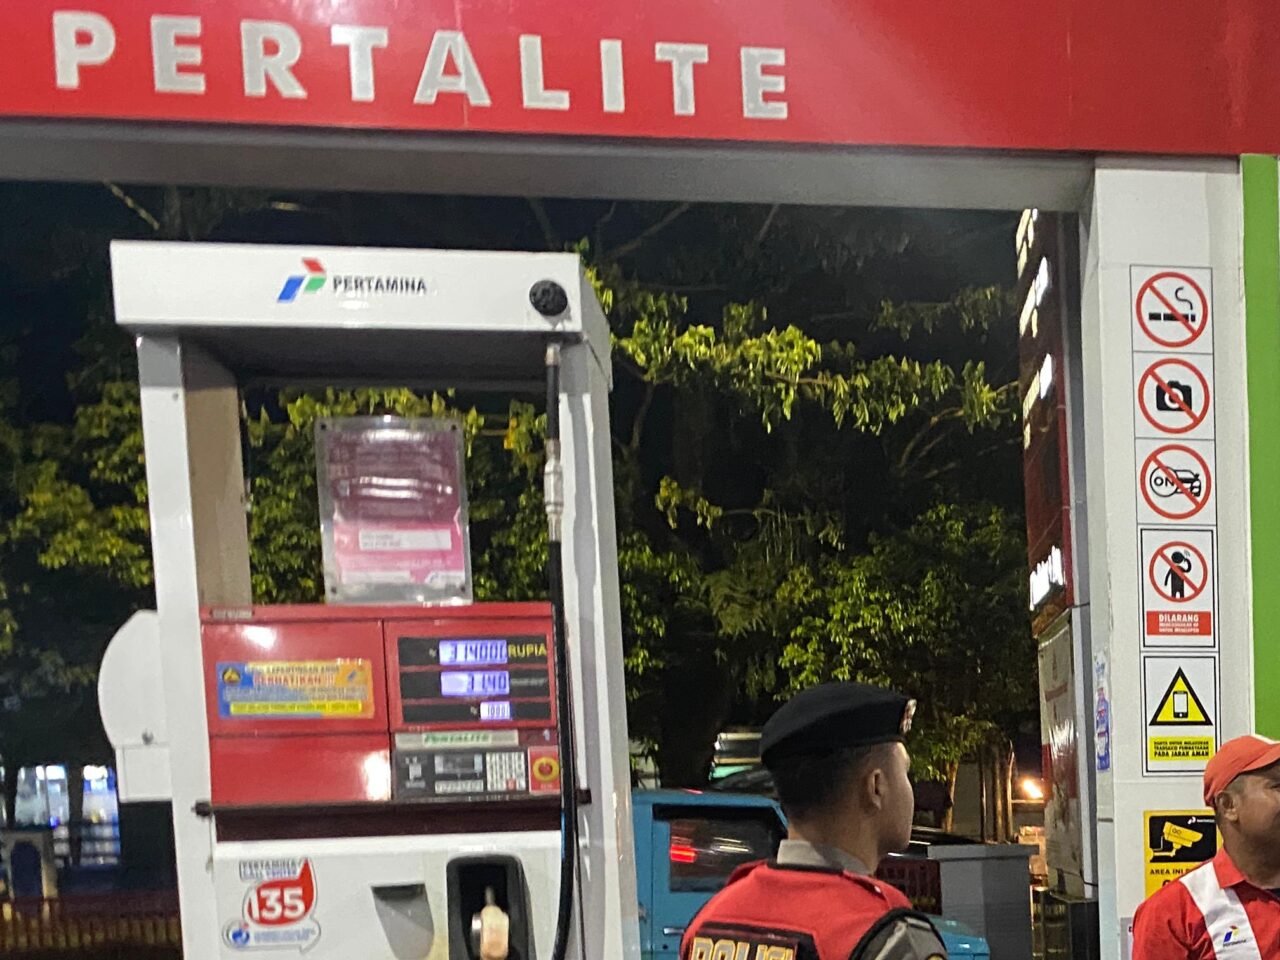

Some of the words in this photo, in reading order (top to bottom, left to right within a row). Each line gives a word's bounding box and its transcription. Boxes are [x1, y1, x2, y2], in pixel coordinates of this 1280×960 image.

[52, 9, 789, 121] PERTALITE
[333, 275, 427, 295] PERTAMINA
[1153, 476, 1175, 487] ON
[1158, 613, 1199, 622] DILARANG
[247, 884, 306, 922] 135
